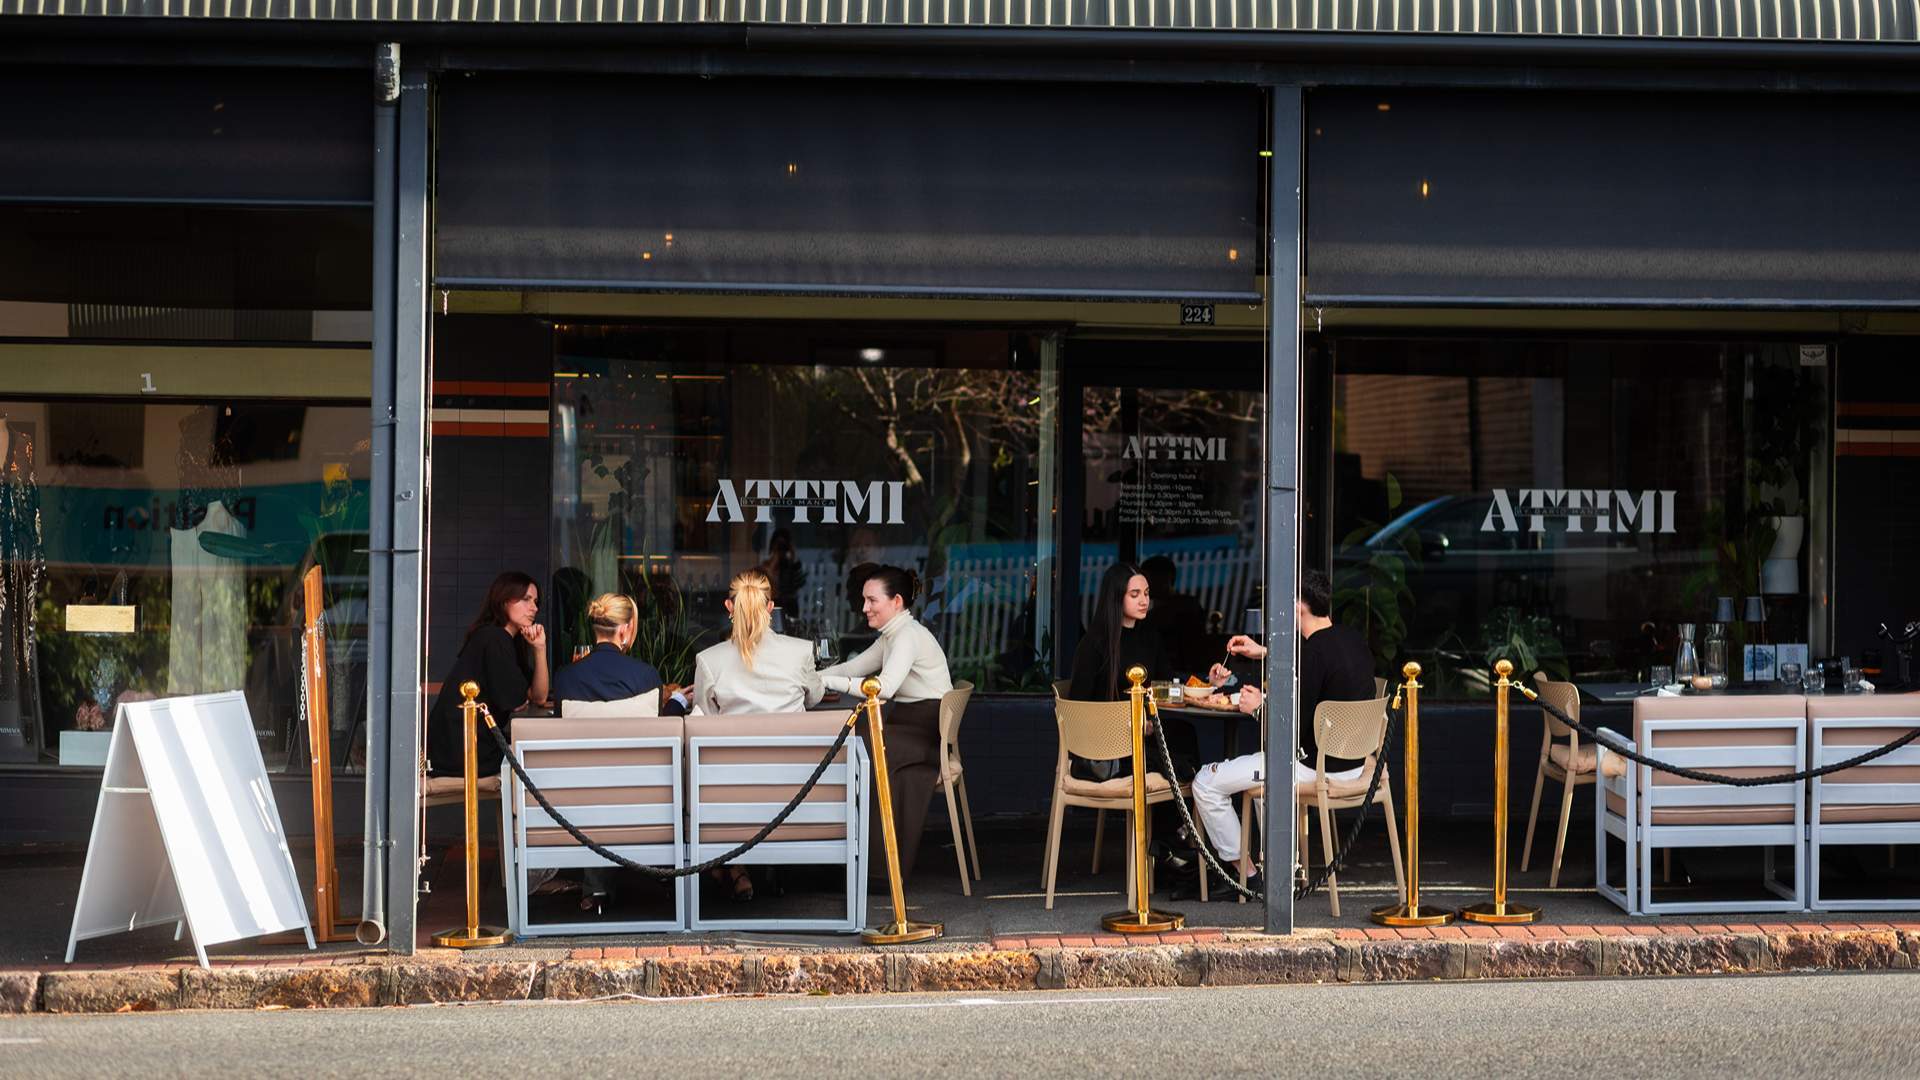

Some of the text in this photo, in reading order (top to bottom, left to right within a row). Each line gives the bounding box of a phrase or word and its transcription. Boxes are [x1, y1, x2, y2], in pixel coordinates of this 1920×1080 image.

[1185, 307, 1211, 322] 224
[141, 373, 157, 392] 1
[1122, 435, 1227, 461] ATTIMI
[705, 479, 905, 524] ATTIMI
[1480, 488, 1677, 533] ATTIMI
